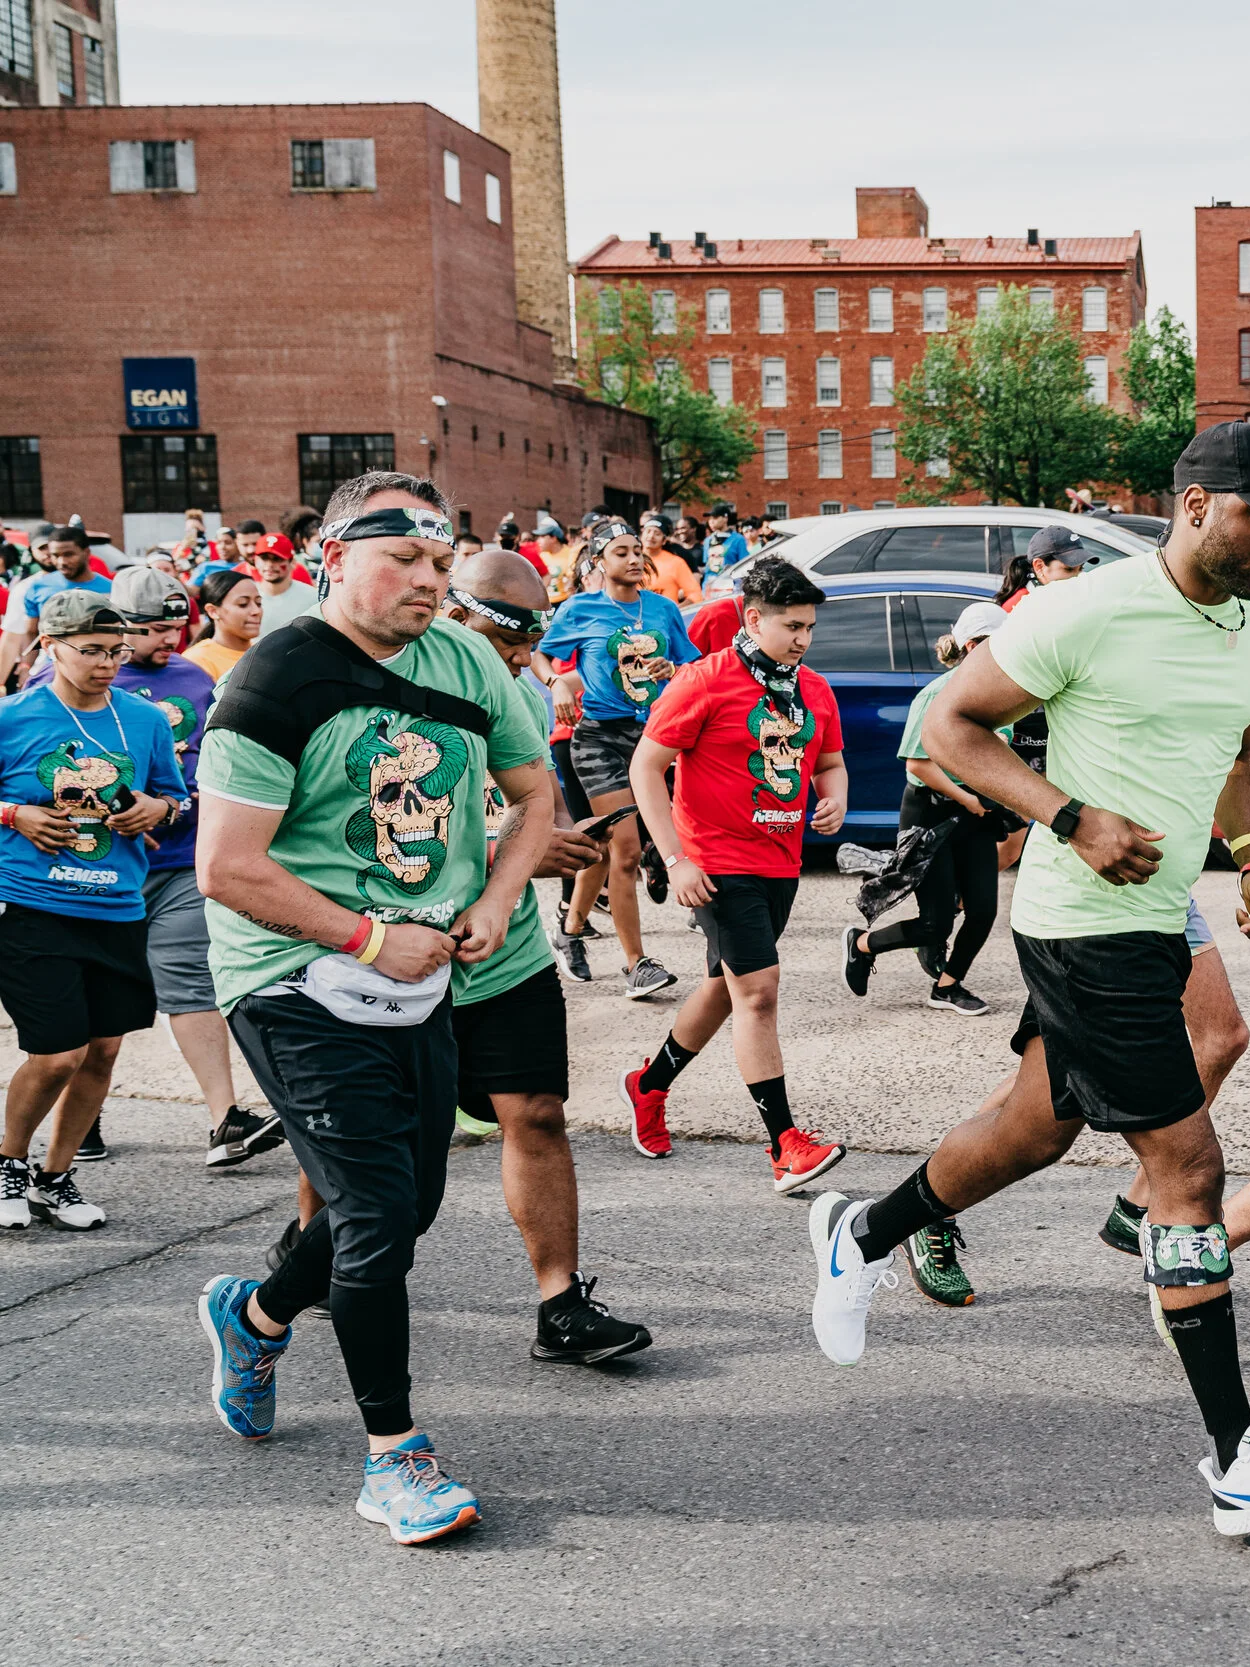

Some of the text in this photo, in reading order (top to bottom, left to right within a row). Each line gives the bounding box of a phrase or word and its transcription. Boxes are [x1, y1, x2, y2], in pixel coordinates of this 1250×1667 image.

[130, 389, 188, 407] EGAN
[132, 411, 189, 425] SIGN
[752, 808, 802, 823] NEMESIS
[47, 865, 119, 885] NEMESIS
[363, 899, 455, 924] NEMESIS
